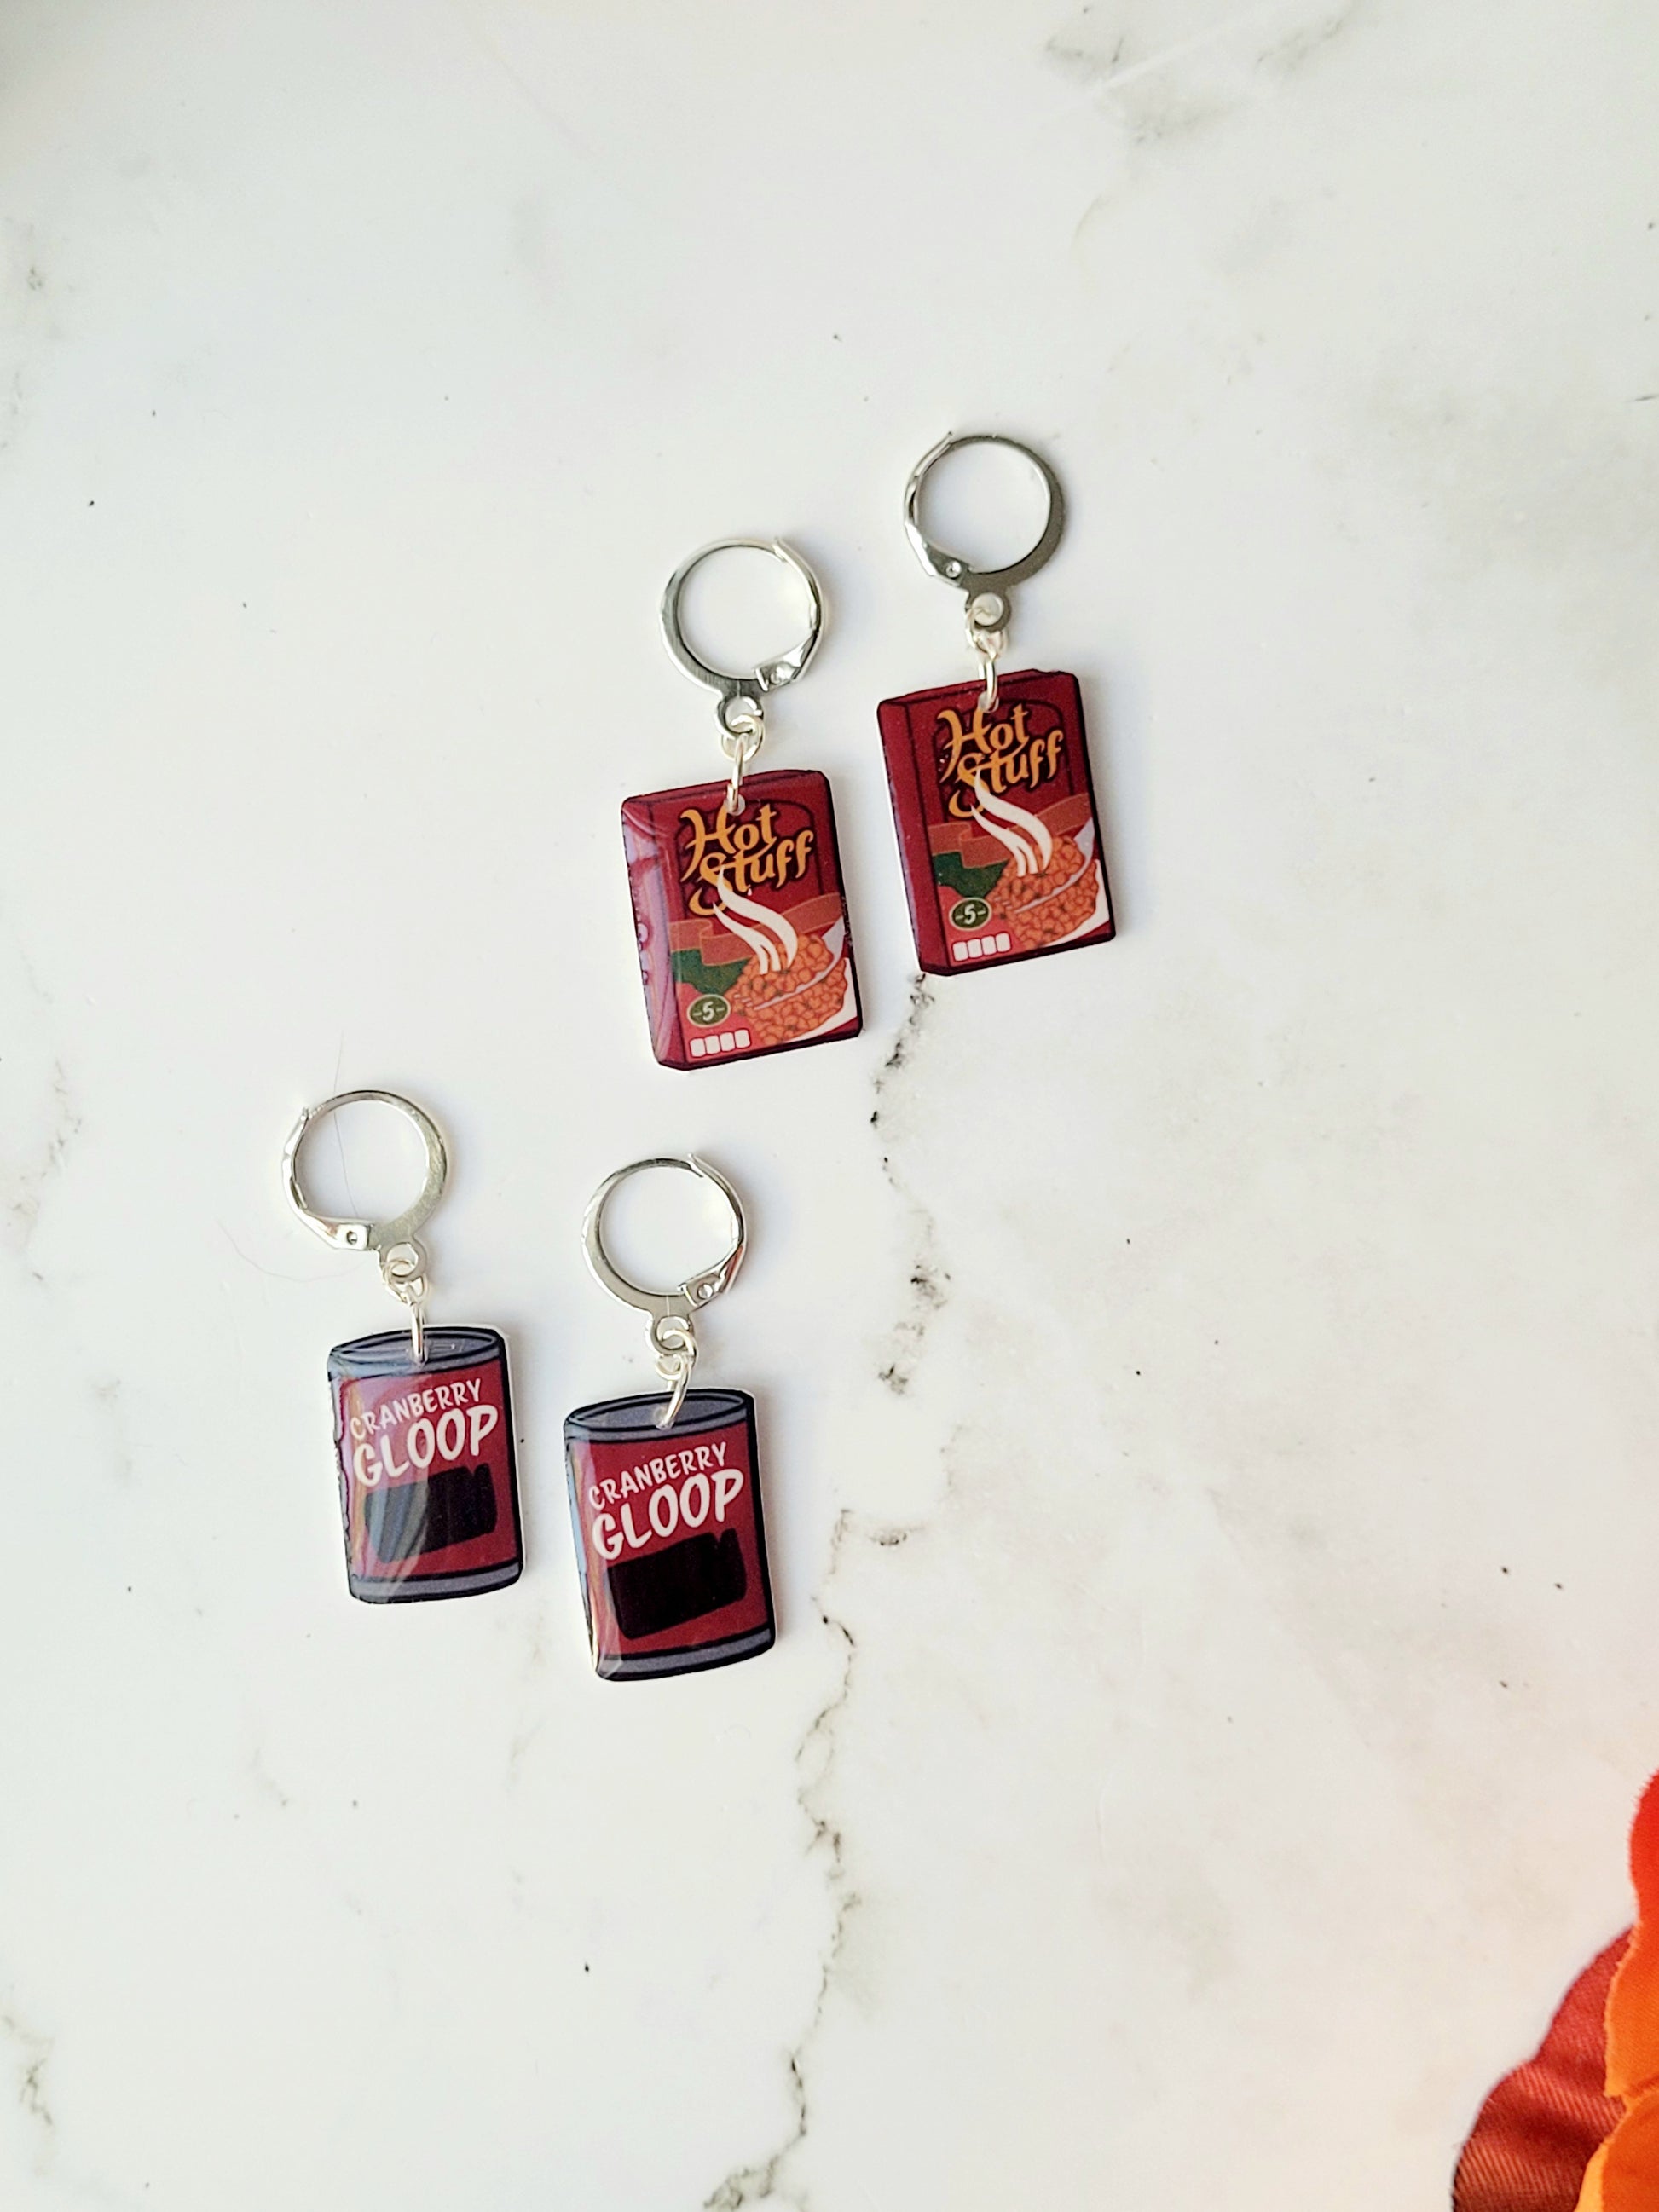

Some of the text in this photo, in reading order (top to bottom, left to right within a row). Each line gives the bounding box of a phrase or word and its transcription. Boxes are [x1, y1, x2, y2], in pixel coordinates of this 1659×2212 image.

[937, 702, 1032, 783] Hot
[948, 729, 1065, 818] Stuff
[679, 803, 777, 883] Hot
[688, 830, 815, 916] Stuff
[350, 1377, 482, 1441] CRANBERRY
[353, 1405, 499, 1487] GLOOP
[588, 1441, 727, 1510] CRANBERRY
[592, 1468, 744, 1560] GLOOP
